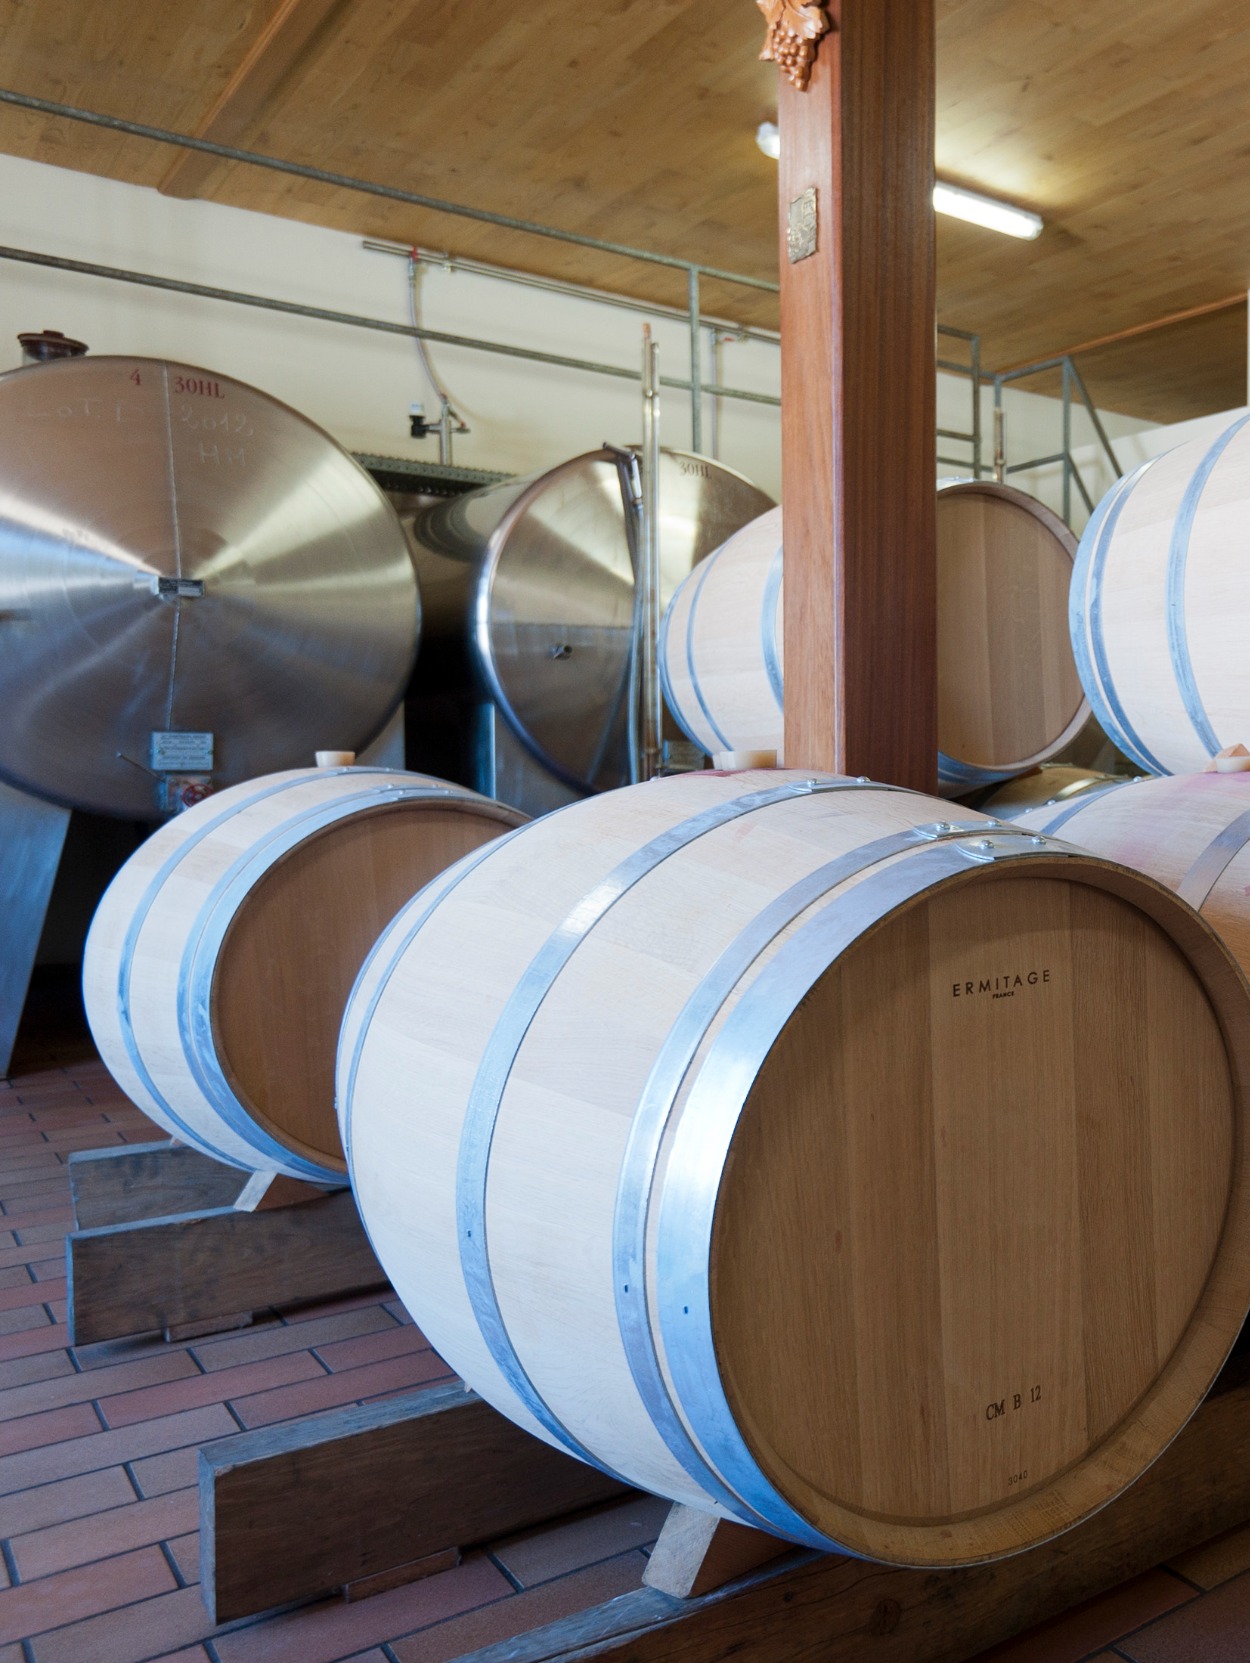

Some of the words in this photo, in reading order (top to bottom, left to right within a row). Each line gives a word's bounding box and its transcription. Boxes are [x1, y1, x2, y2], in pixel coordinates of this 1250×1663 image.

[174, 375, 225, 399] 30HL
[679, 461, 712, 480] 30HL
[952, 969, 1050, 997] ERMITAGE
[992, 991, 1015, 999] FRANCE
[985, 1399, 1006, 1420] CM
[1013, 1393, 1022, 1410] B
[1030, 1384, 1042, 1403] 12
